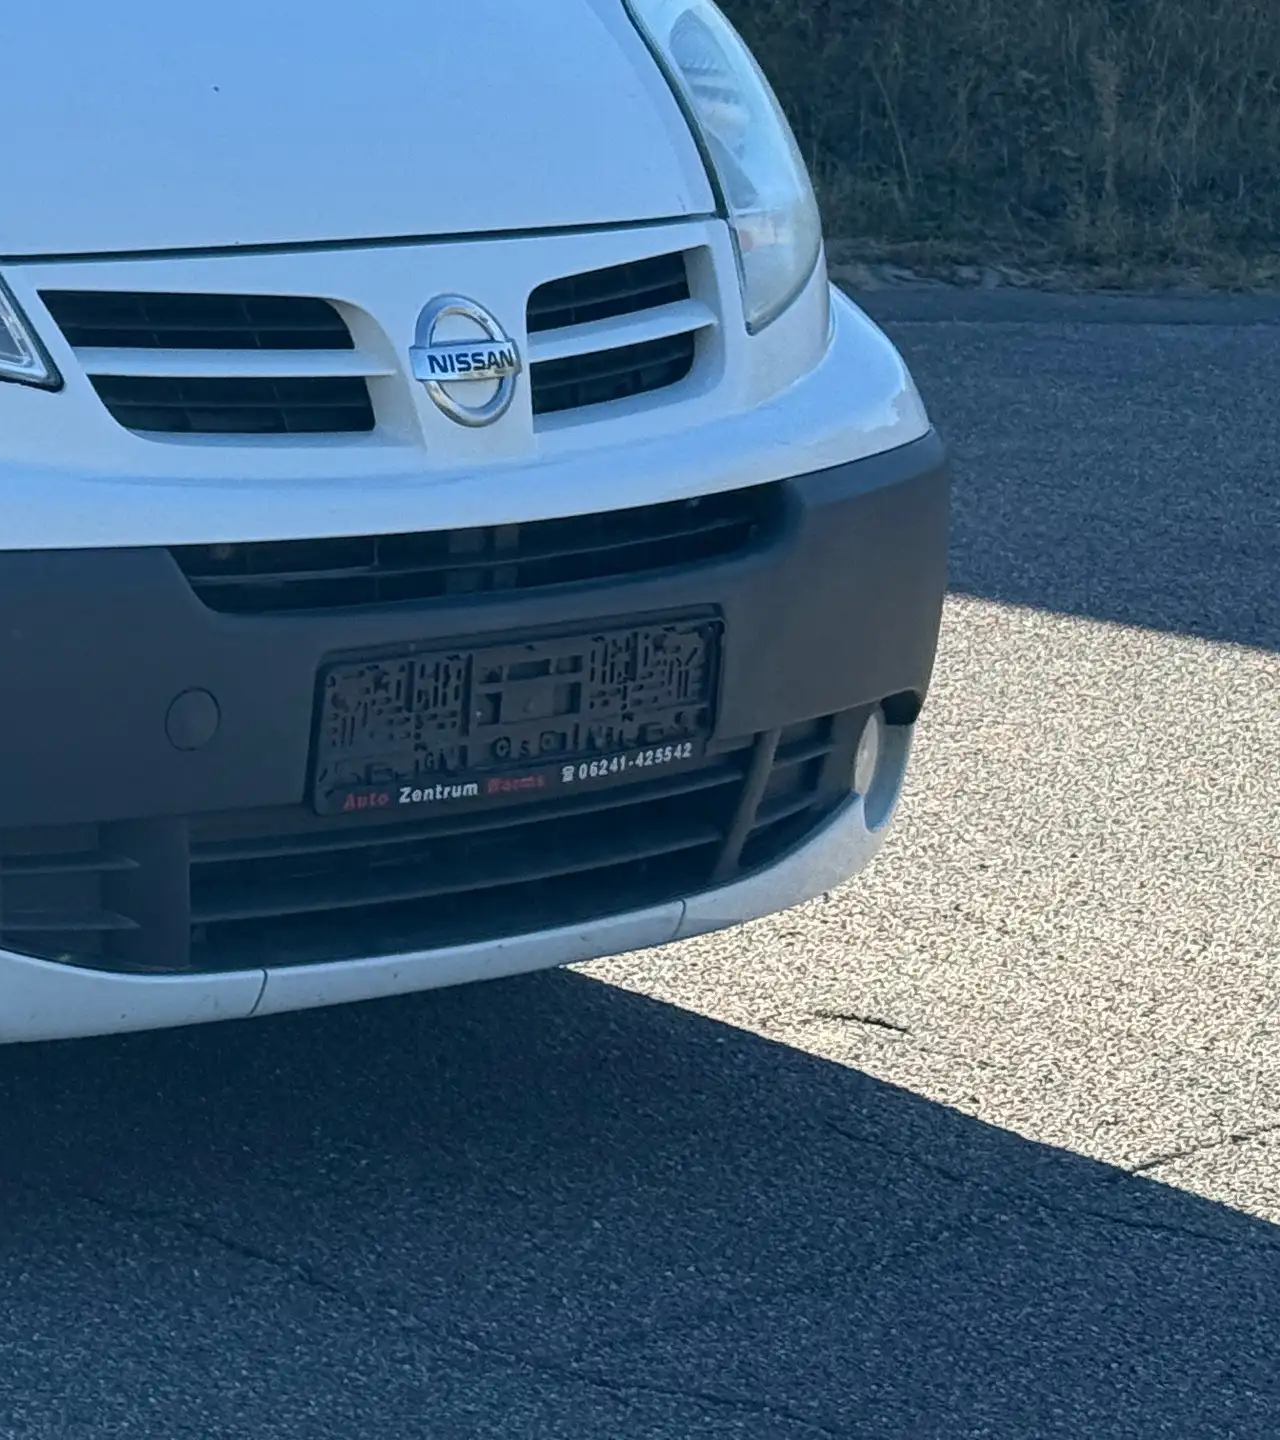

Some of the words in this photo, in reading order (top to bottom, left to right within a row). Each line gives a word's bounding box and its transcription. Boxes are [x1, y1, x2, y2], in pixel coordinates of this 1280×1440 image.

[427, 348, 514, 374] NISSAN
[343, 790, 390, 810] Auto
[399, 782, 478, 804] Zentrum
[579, 742, 693, 779] 06241-425542
